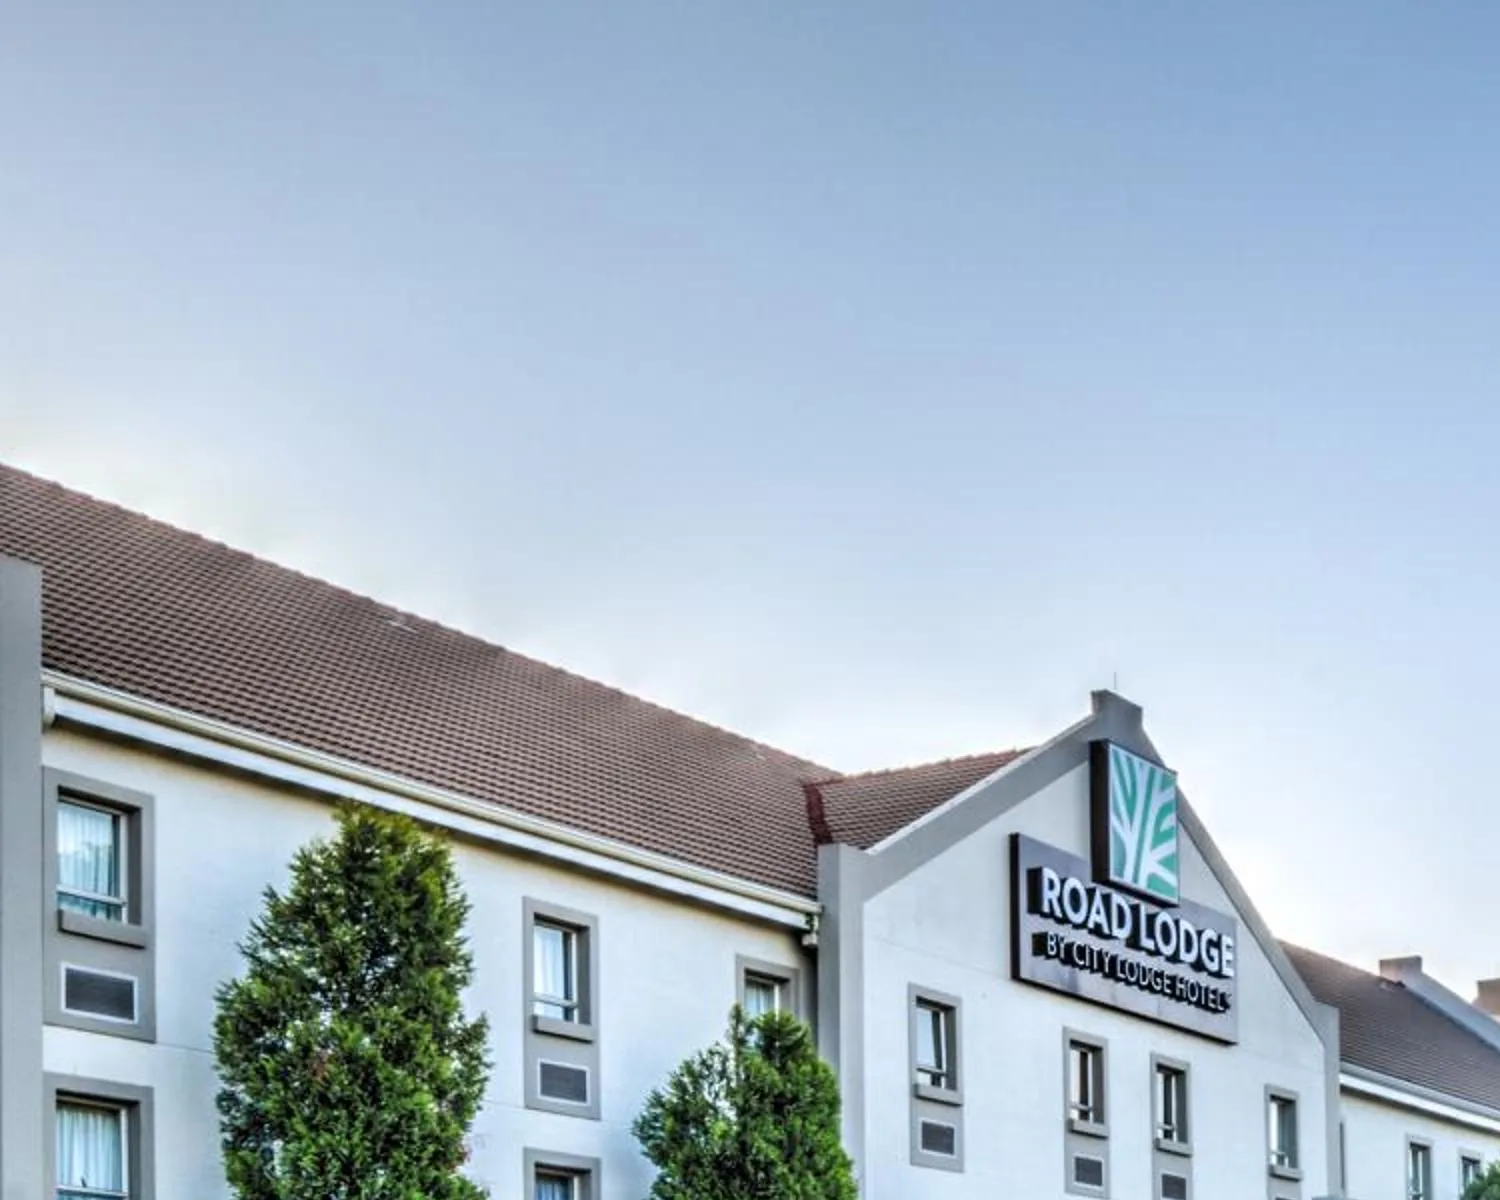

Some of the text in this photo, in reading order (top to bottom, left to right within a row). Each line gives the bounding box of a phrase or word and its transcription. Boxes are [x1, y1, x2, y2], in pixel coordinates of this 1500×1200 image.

[1042, 866, 1235, 977] ROAD LODGE
[1046, 932, 1066, 956] BY
[1073, 943, 1113, 974] CITY
[1115, 957, 1174, 993] LODGE
